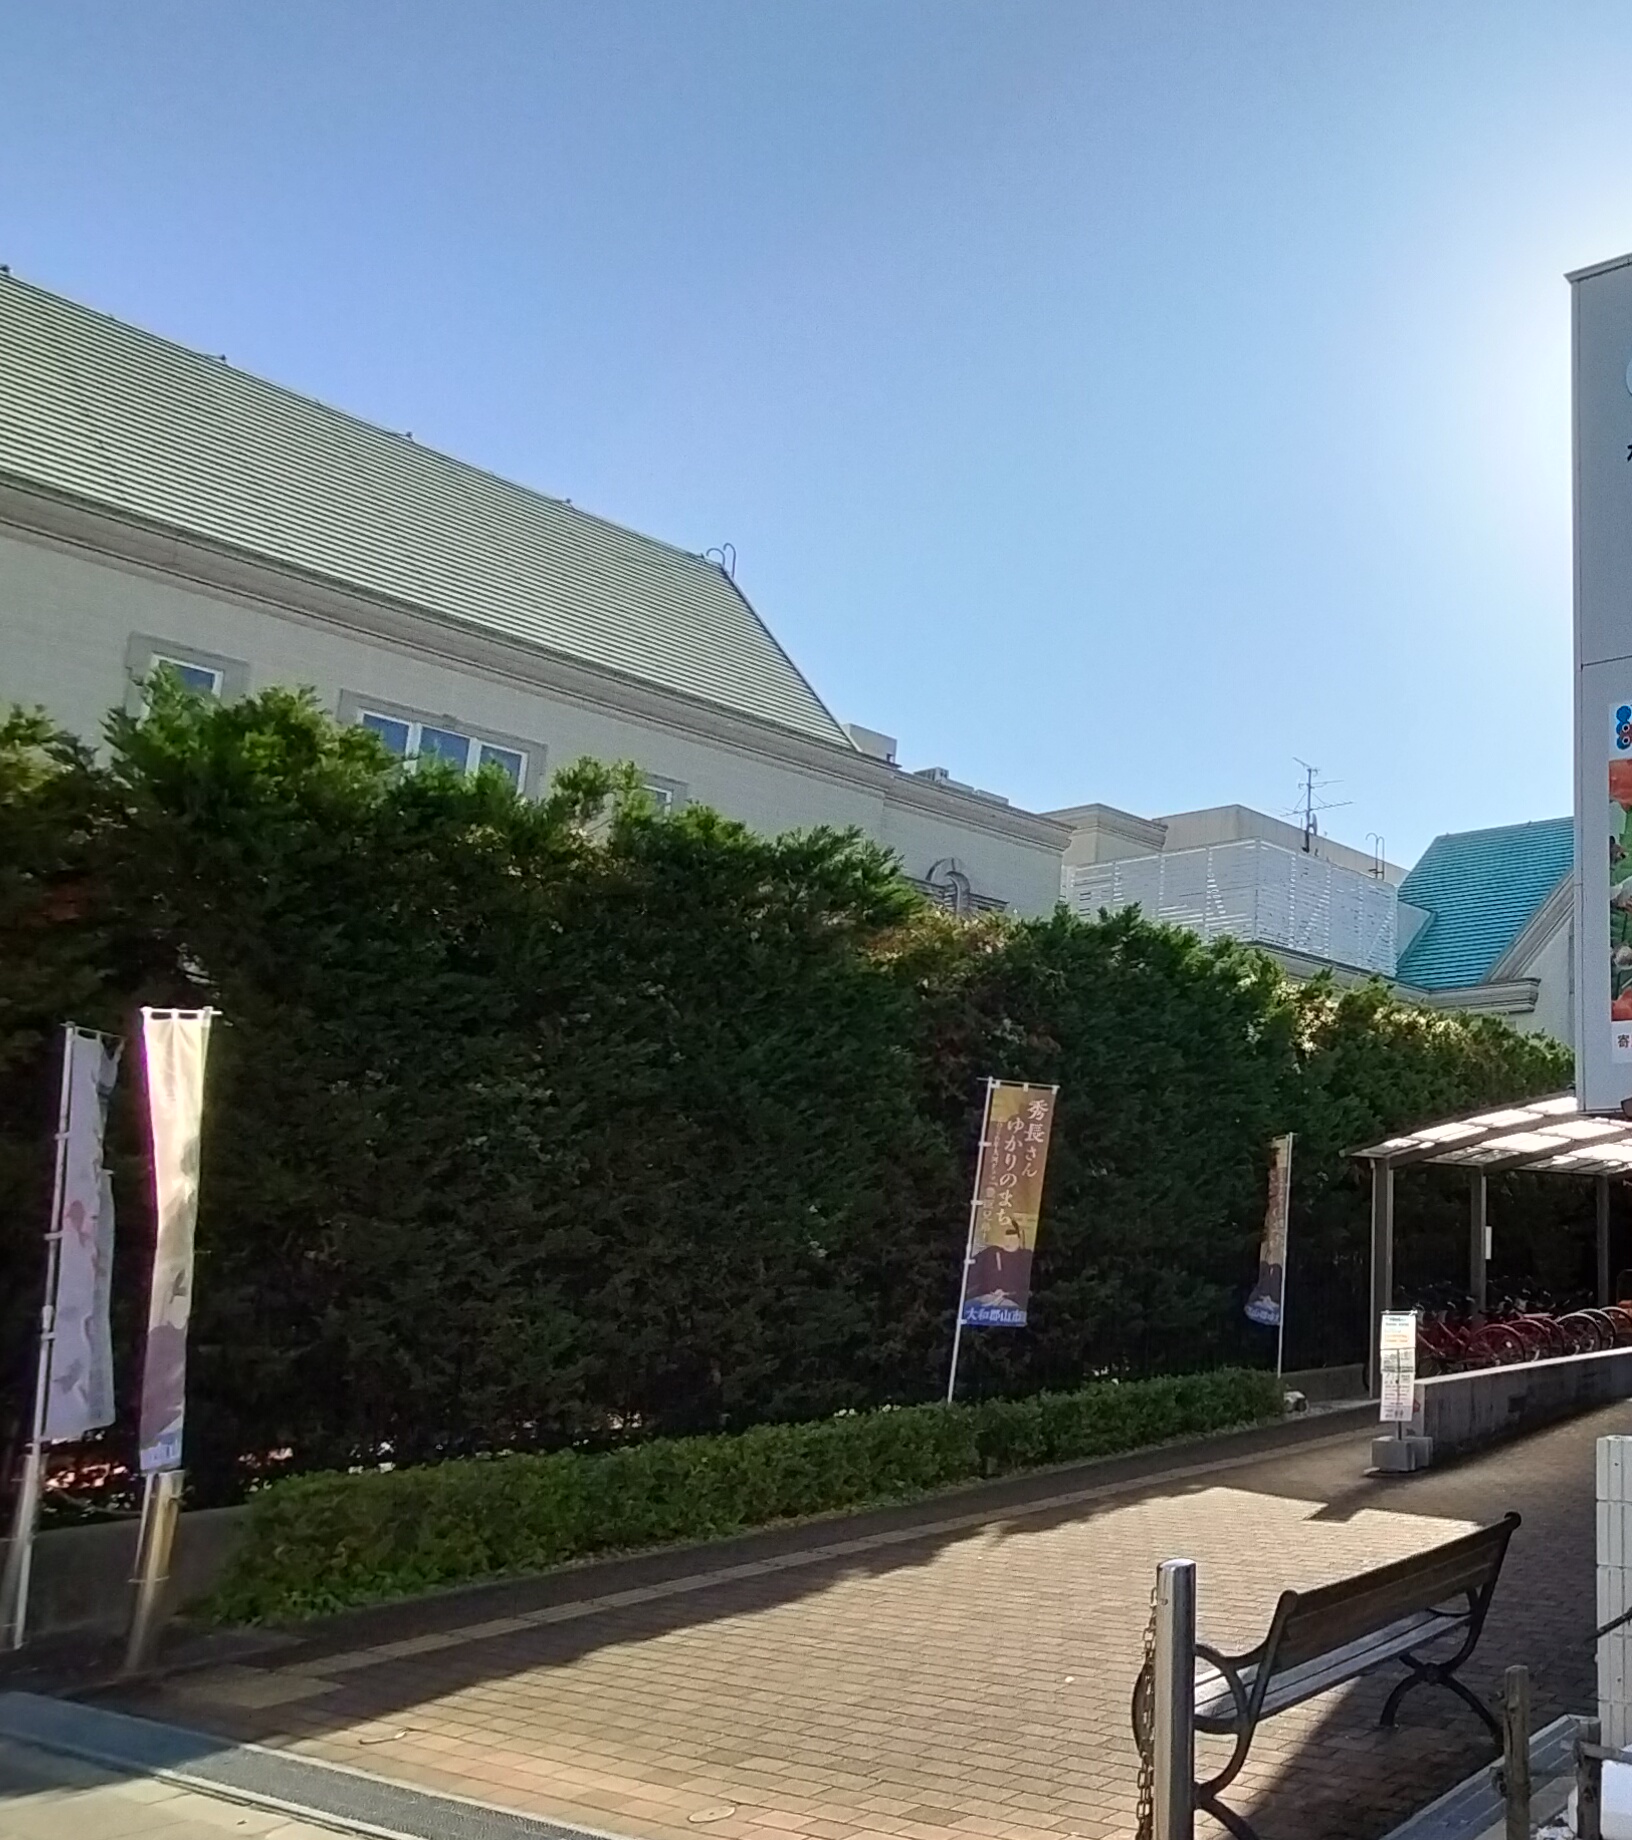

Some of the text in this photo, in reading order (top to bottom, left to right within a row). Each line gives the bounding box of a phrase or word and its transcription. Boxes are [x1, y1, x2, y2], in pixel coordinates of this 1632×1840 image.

[996, 1117, 1025, 1227] ゆかりのまち
[1021, 1100, 1049, 1178] 秀長さん
